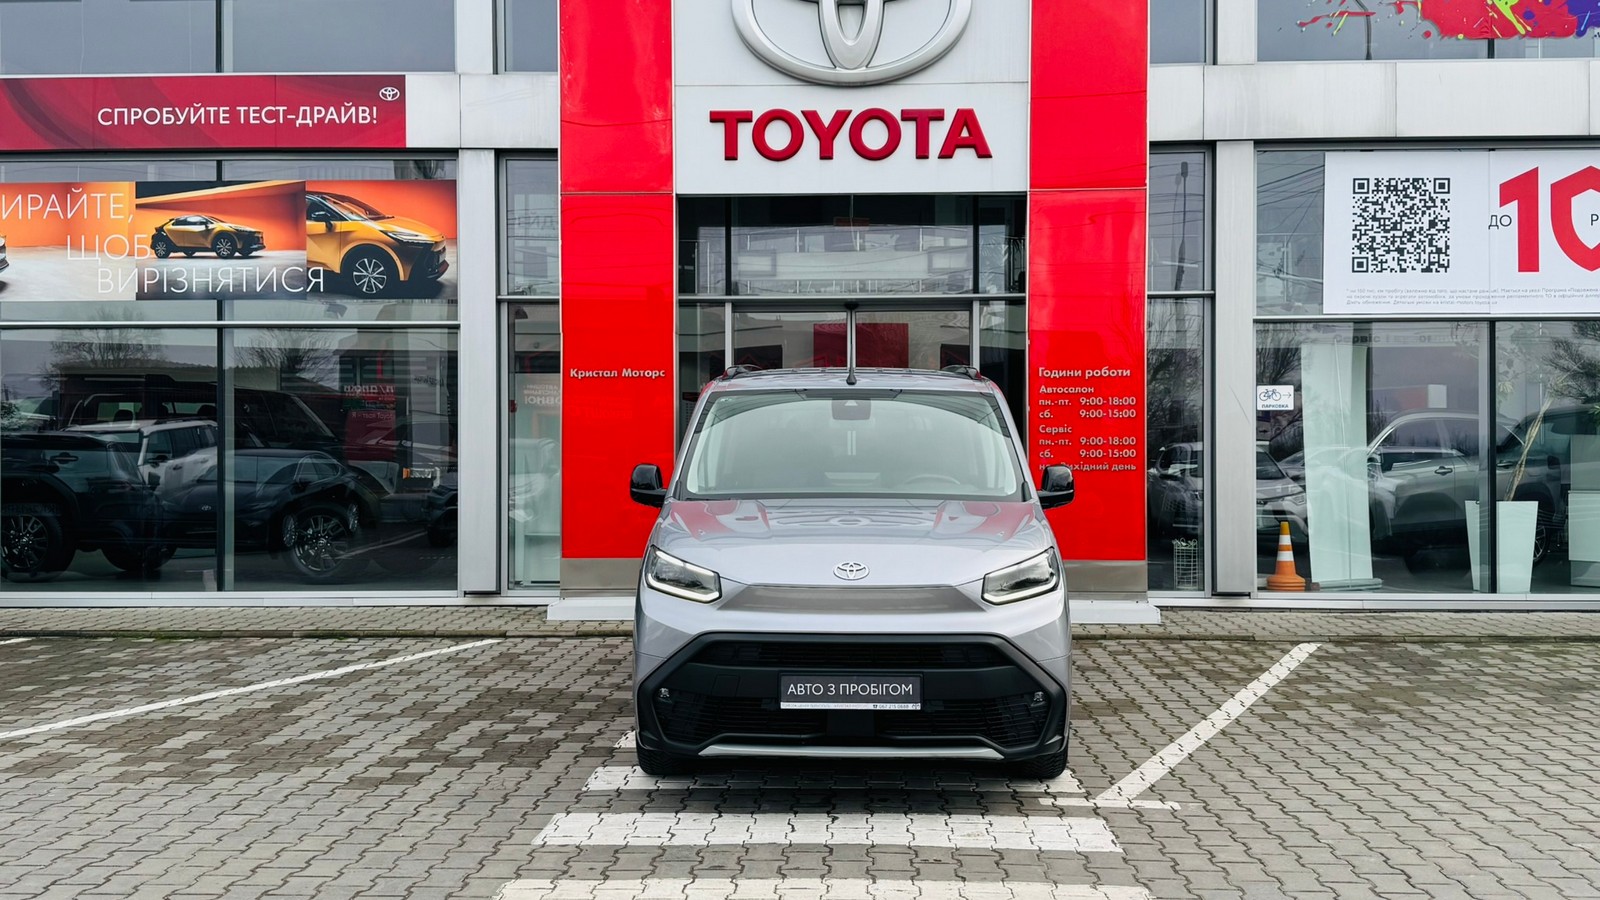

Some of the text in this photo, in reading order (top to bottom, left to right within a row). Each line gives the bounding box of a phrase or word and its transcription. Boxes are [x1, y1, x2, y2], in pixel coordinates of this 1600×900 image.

[98, 102, 378, 127] СПРОБУЙТЕ ТЕСТ-ДРАЙВ!
[709, 108, 993, 162] TOYOTA
[1488, 214, 1513, 230] ДО
[67, 234, 151, 265] ЩОБ
[97, 267, 324, 293] ВИРІЗНЯТИСЯ
[570, 368, 666, 379] Кристал Моторс
[1038, 366, 1131, 379] Години роботи
[1039, 385, 1095, 394] Автосалон
[1039, 409, 1054, 418] сб.
[1039, 424, 1073, 435] Сервіс
[1039, 449, 1054, 458] сб.
[787, 683, 913, 696] АВТО З ПРОБІГОМ
